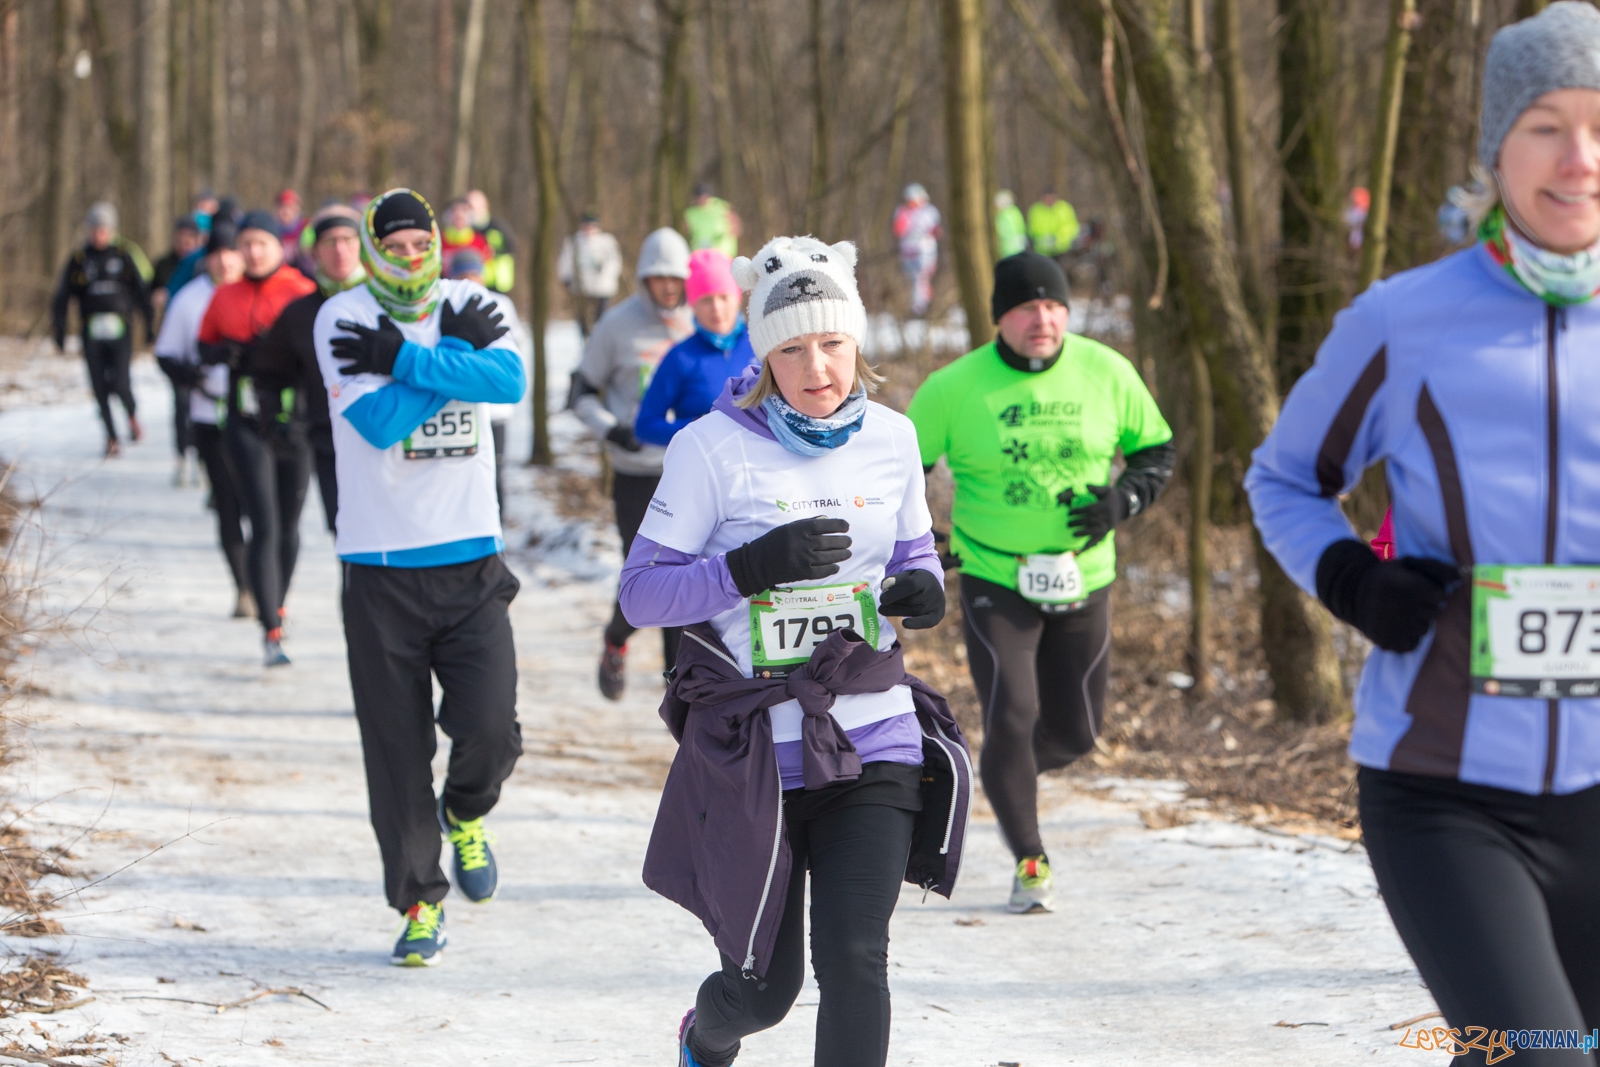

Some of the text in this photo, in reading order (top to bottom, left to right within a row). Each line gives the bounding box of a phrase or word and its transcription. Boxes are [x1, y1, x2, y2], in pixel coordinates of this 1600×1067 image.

[422, 411, 472, 437] 655
[999, 402, 1083, 427] 4 BIEGI
[1026, 571, 1076, 592] 1945
